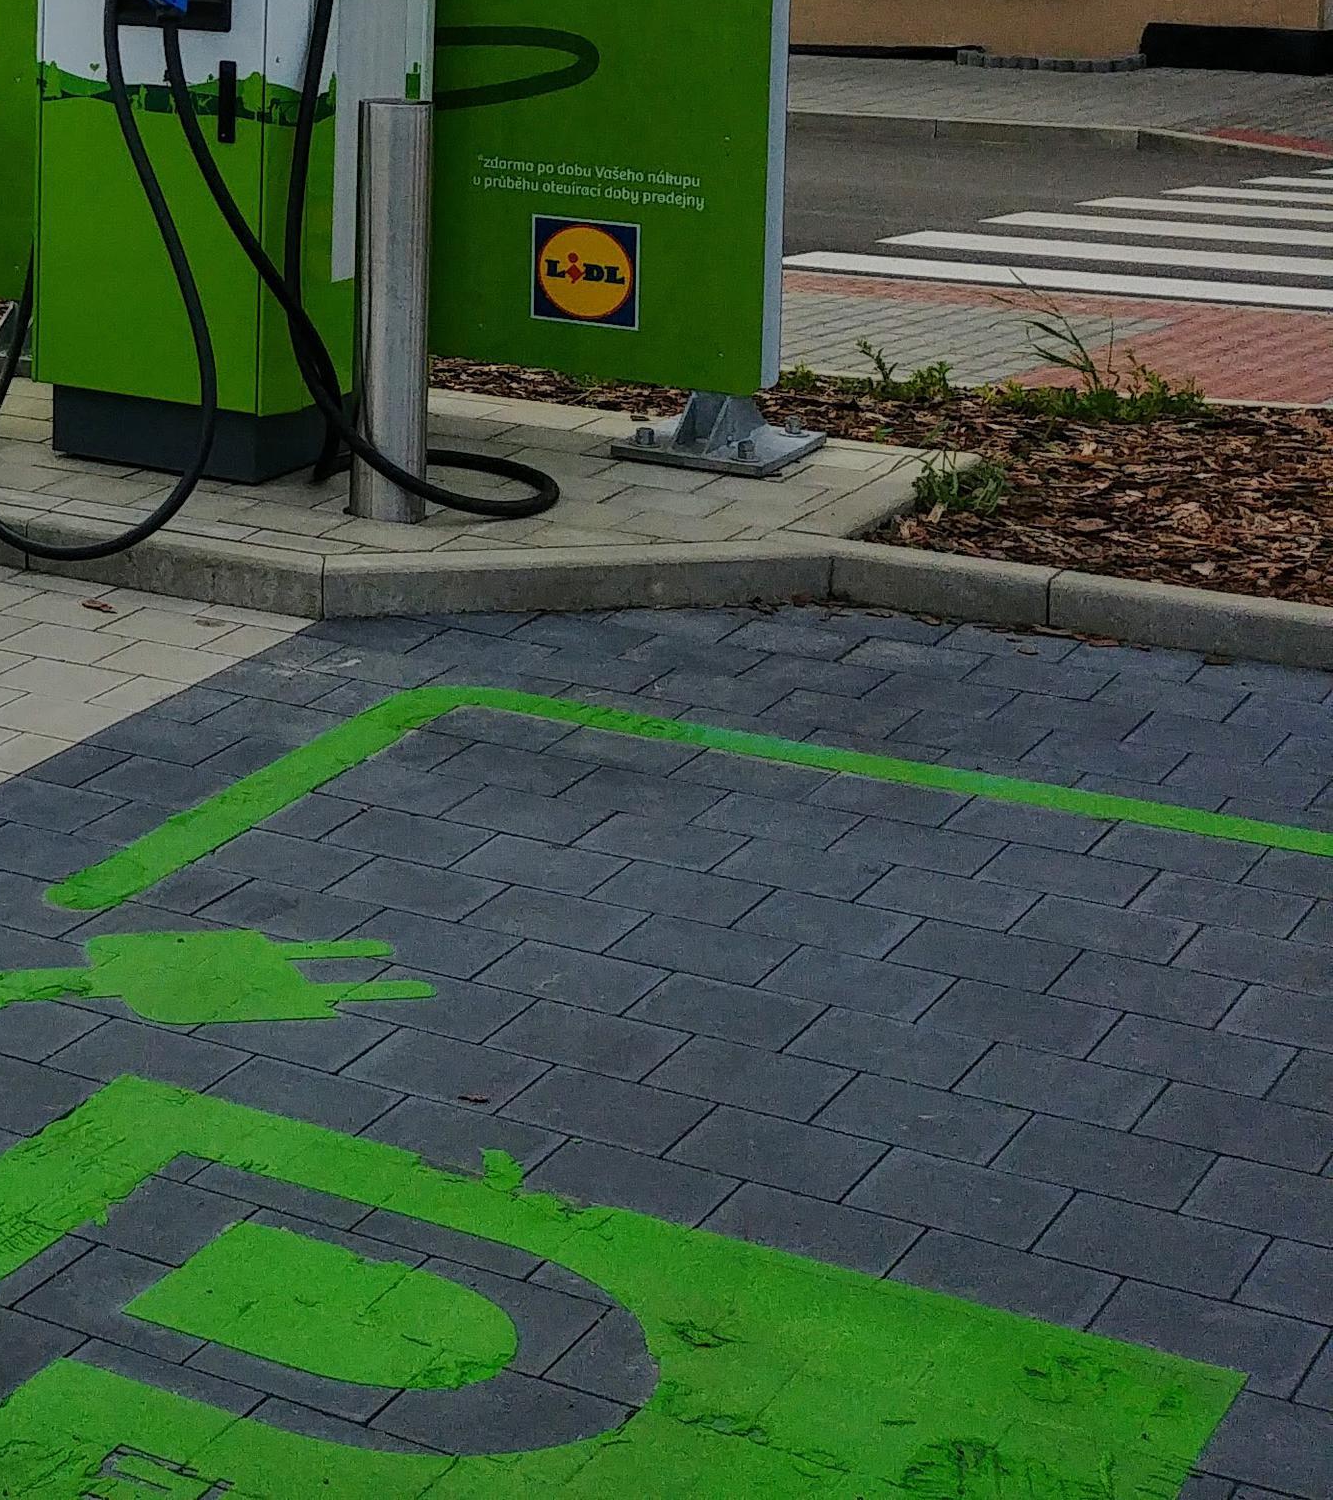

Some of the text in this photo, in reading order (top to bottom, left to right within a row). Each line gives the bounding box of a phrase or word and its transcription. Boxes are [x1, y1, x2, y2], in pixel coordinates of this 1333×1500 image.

[537, 163, 554, 176] po
[557, 162, 592, 178] dobu
[595, 165, 645, 183] Vašeho
[647, 169, 701, 189] nákupu
[484, 175, 540, 192] průběhu
[542, 180, 602, 198] otevírací
[604, 186, 640, 205] doby
[642, 191, 705, 212] prodejny
